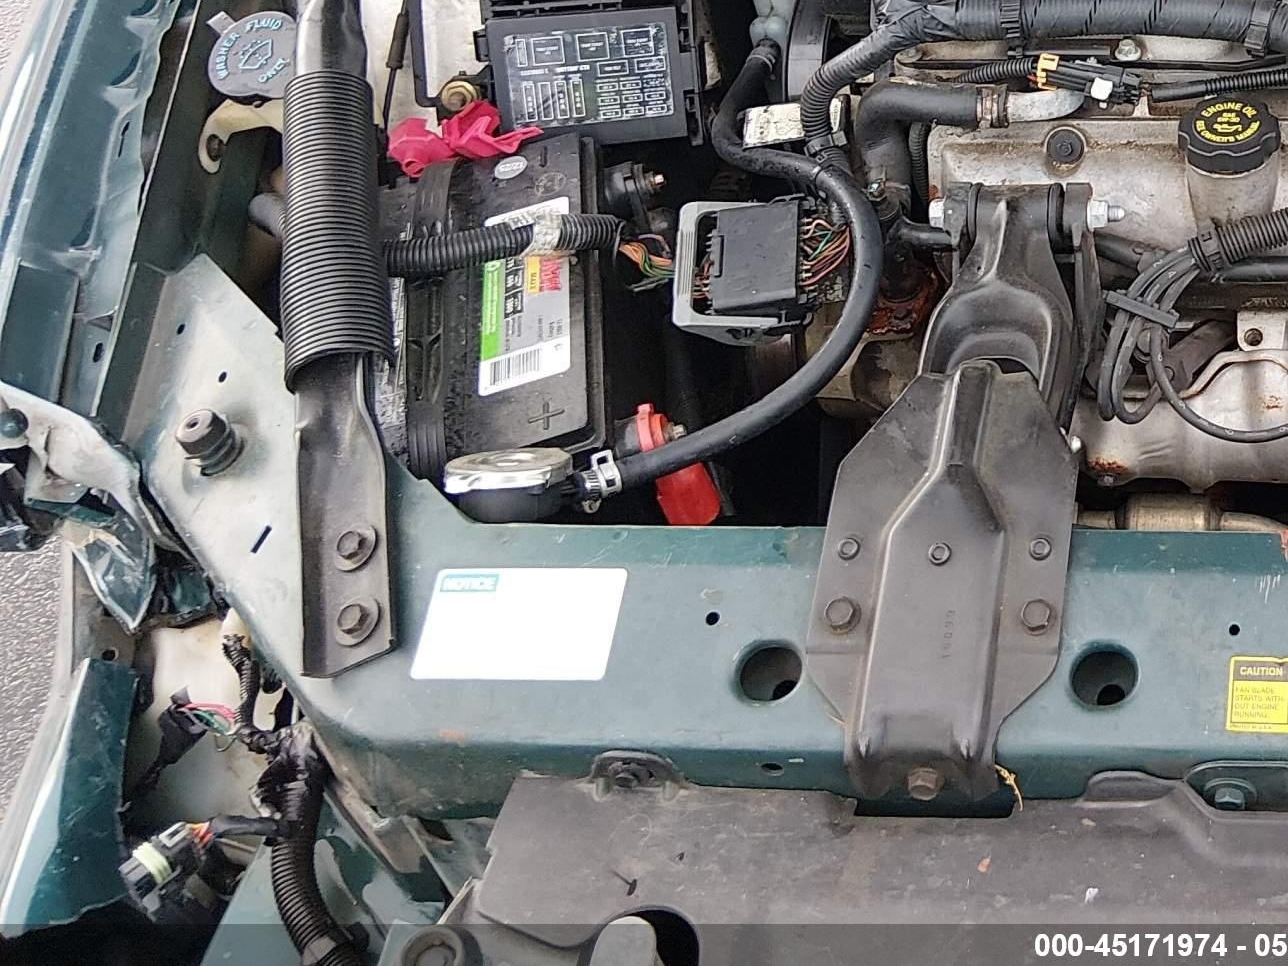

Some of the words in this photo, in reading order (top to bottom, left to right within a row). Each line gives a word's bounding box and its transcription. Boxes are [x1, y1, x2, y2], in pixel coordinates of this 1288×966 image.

[216, 32, 241, 80] WASHER
[245, 18, 282, 34] FLUID
[258, 58, 290, 82] ONLY
[1201, 102, 1243, 117] ENGINE
[1242, 106, 1258, 118] OIL
[441, 576, 497, 591] NOTICE
[1240, 666, 1283, 677] CAUTION
[1252, 703, 1279, 711] ENGINE
